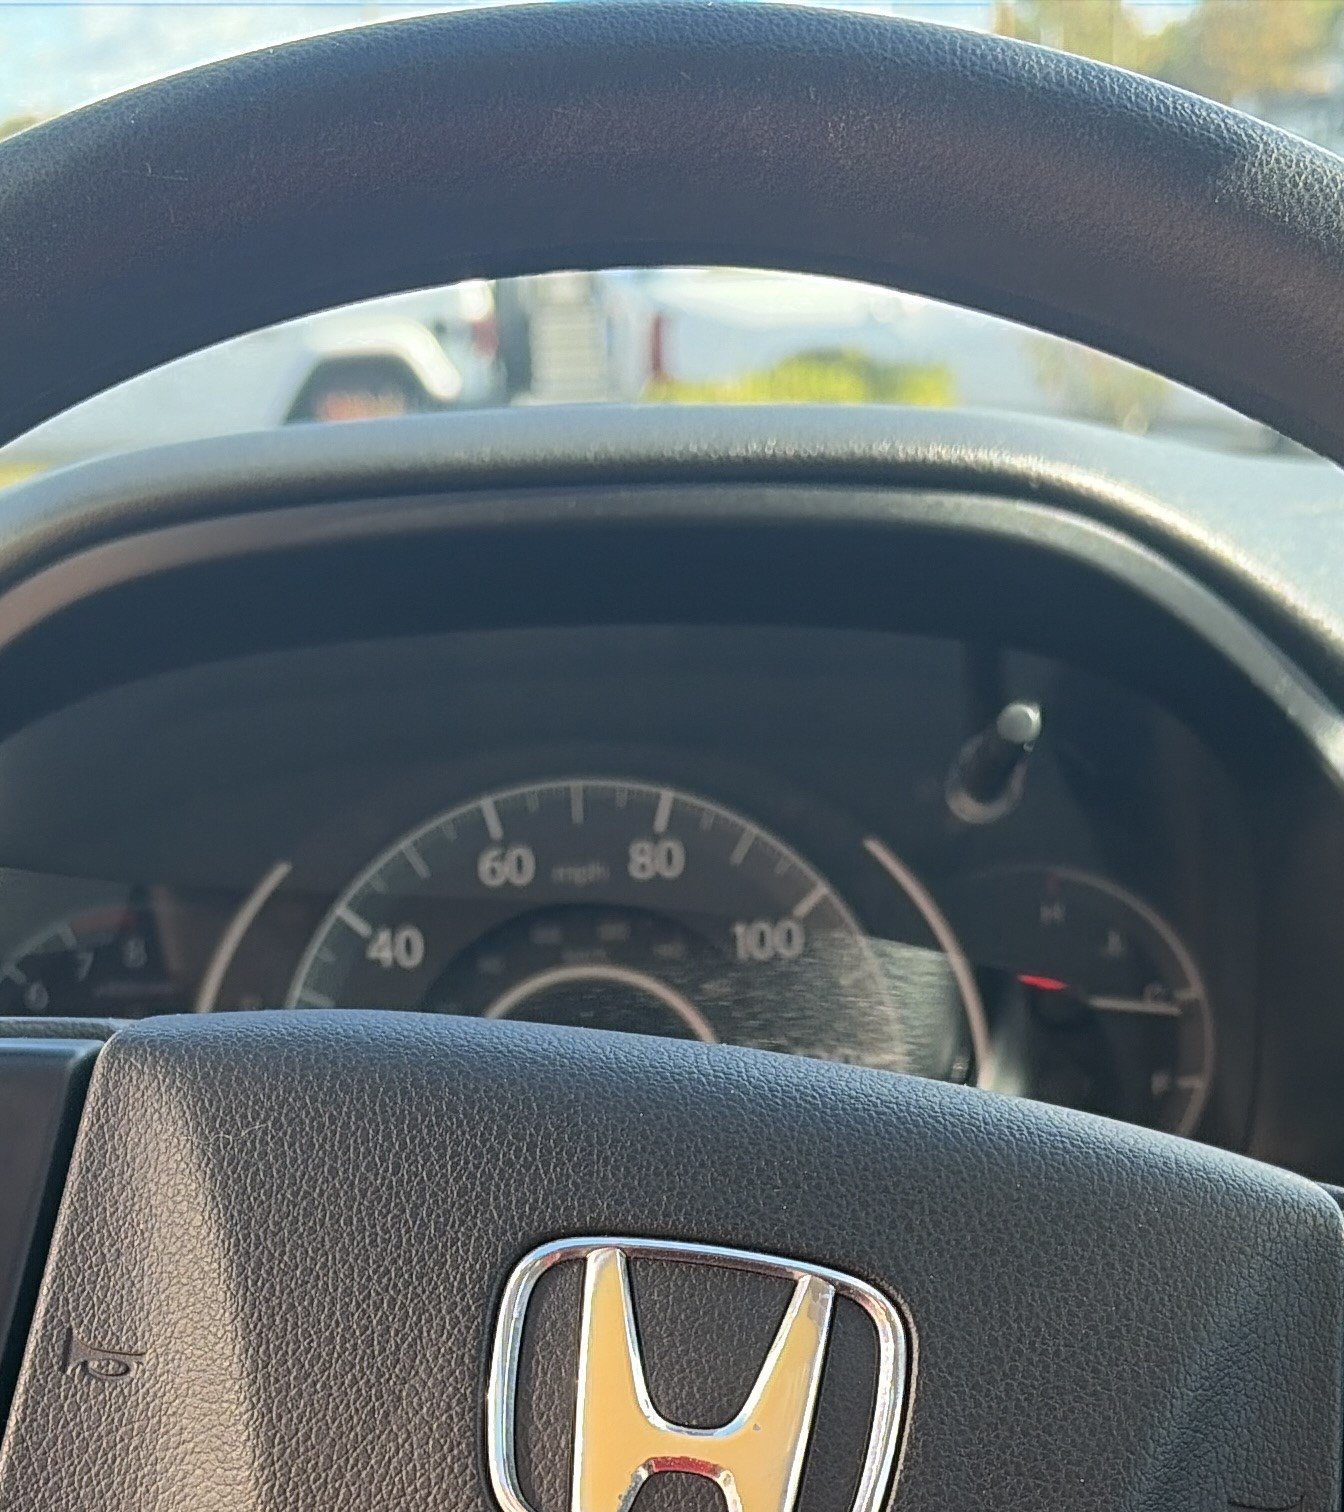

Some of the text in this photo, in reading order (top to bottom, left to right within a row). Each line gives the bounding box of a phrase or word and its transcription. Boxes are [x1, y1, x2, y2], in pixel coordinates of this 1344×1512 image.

[476, 844, 537, 889] 60
[627, 839, 686, 881] 80
[366, 923, 426, 971] 40
[732, 920, 806, 961] 100
